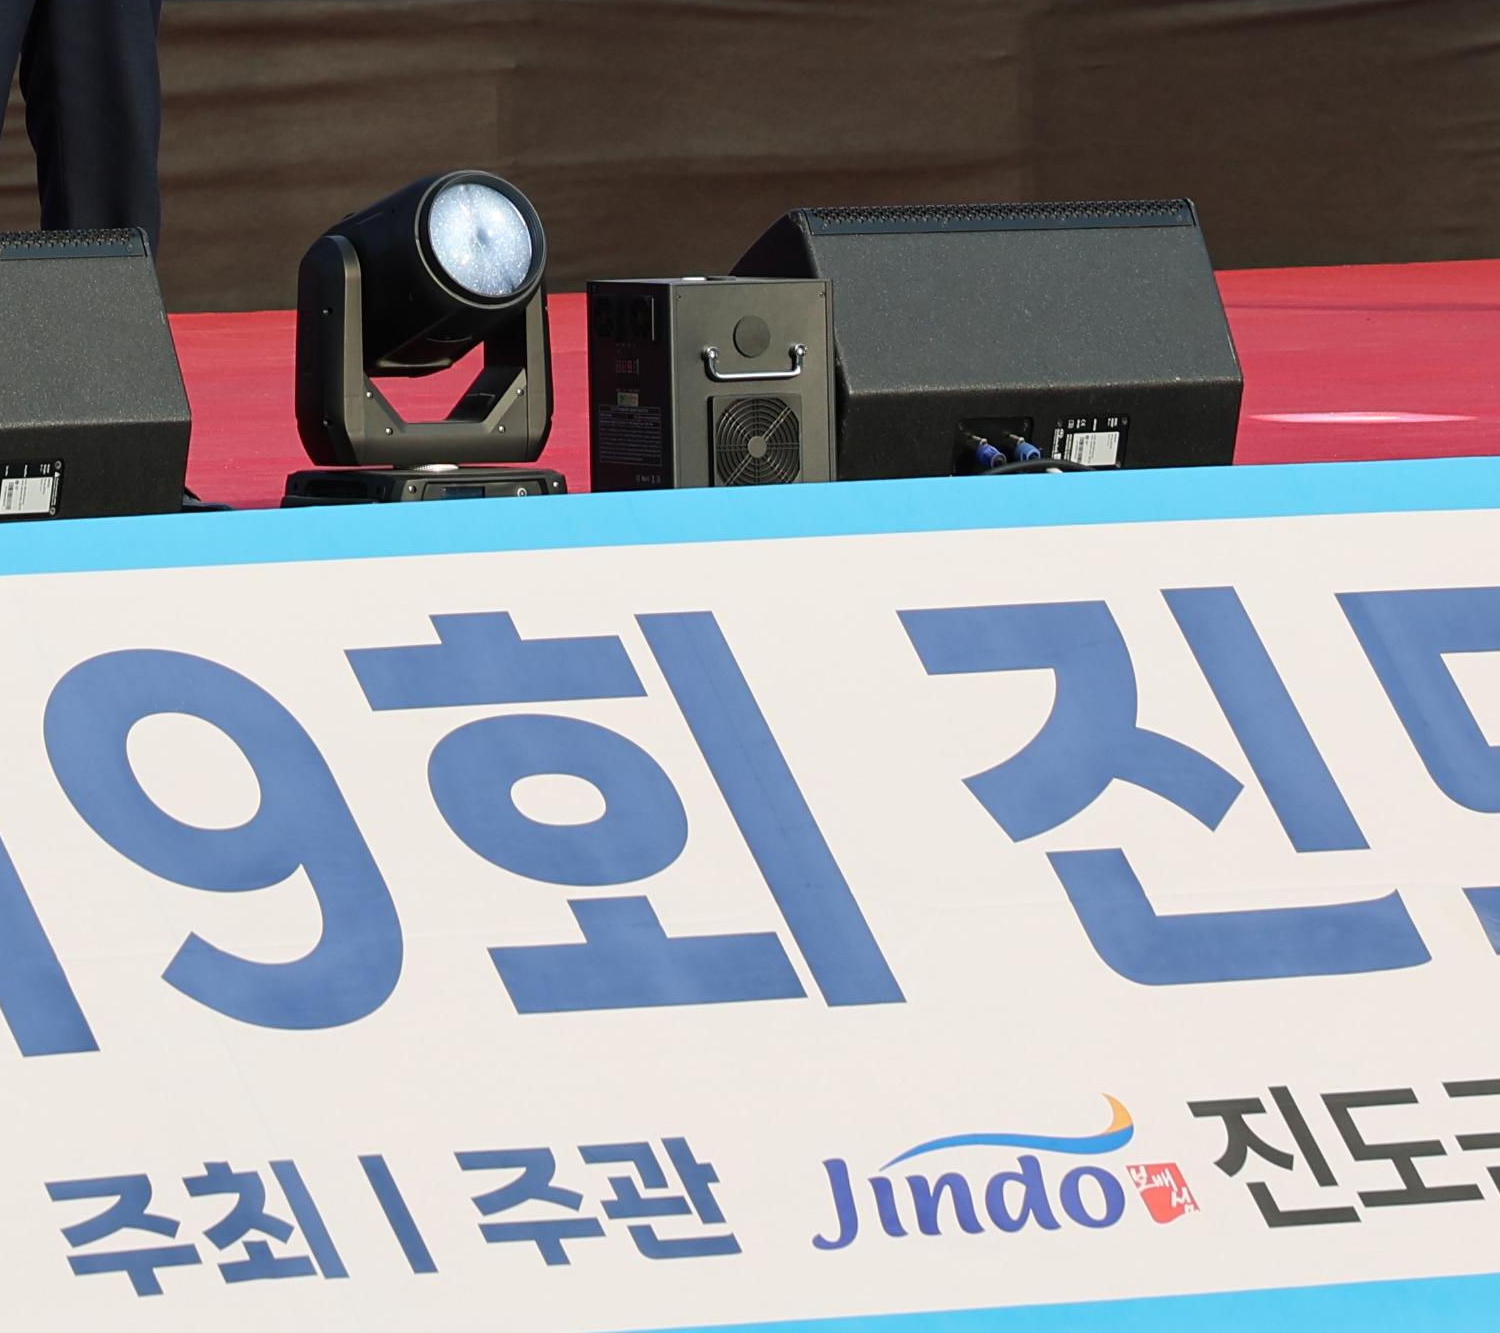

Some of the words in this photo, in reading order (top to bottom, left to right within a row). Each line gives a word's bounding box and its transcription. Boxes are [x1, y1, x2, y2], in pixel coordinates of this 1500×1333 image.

[45, 1160, 349, 1296] 주최
[454, 1136, 744, 1267] 주관
[811, 1154, 1127, 1251] Jindo
